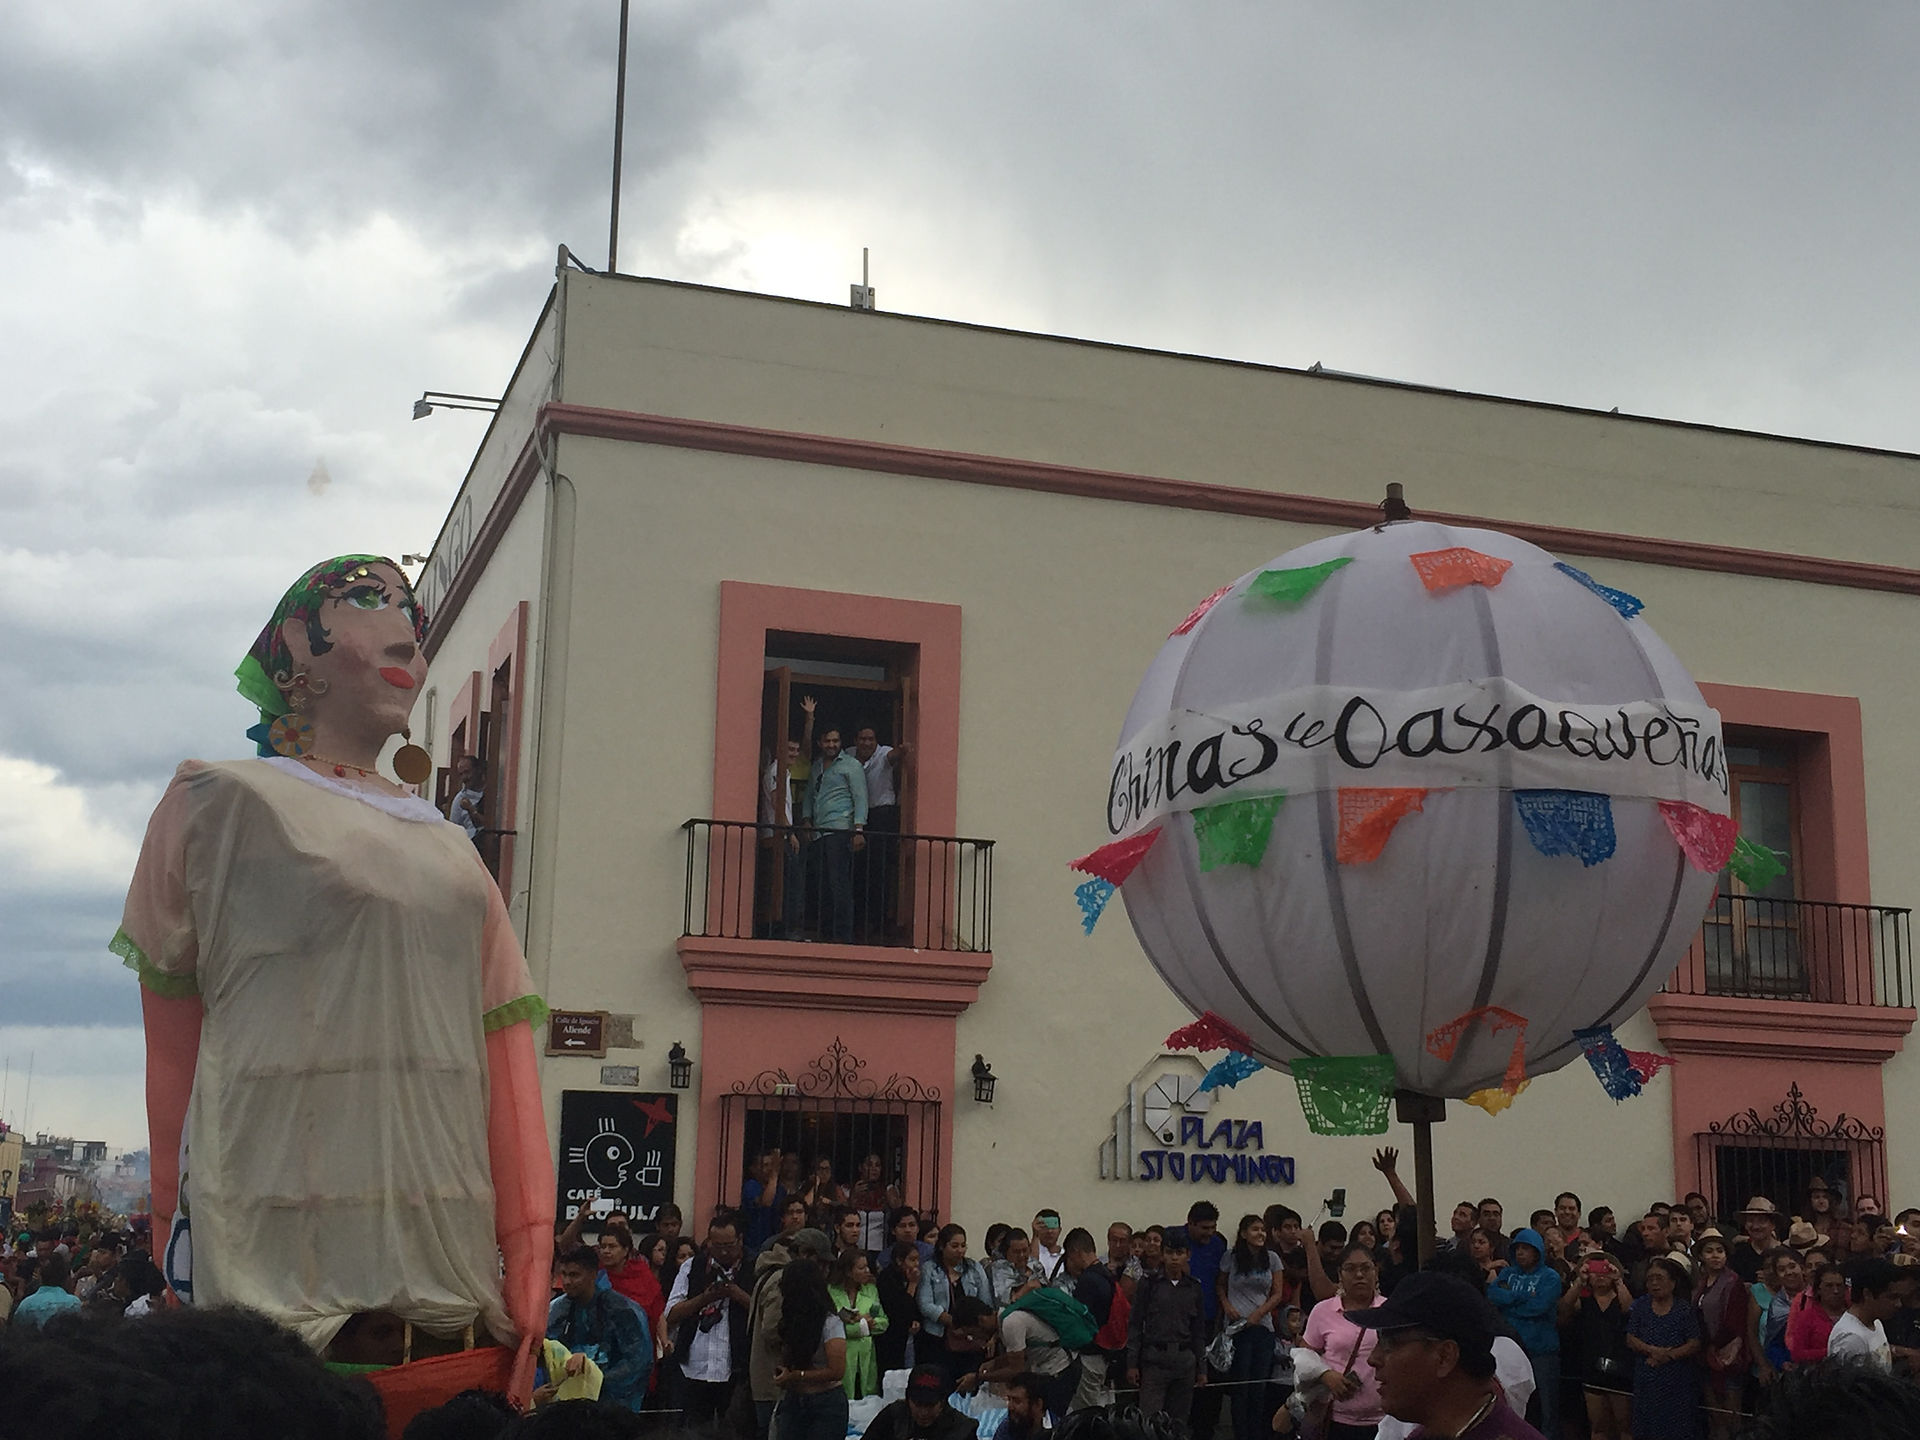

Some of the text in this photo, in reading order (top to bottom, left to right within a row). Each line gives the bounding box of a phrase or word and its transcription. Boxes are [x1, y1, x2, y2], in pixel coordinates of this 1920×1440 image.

[562, 1025, 592, 1035] Allende
[1180, 1116, 1264, 1150] PLAZA
[1140, 1150, 1295, 1185] STO DOMINGO
